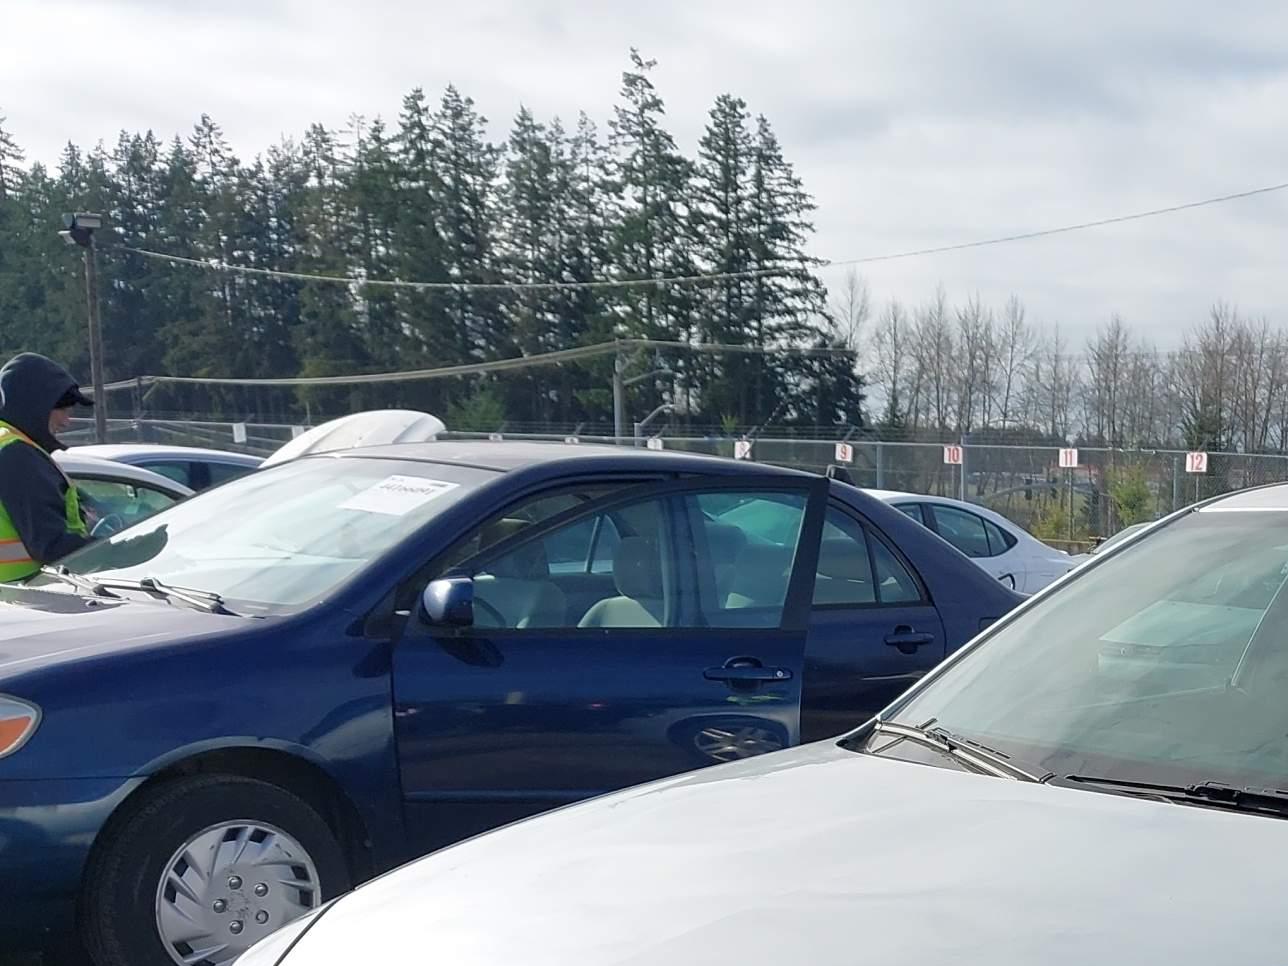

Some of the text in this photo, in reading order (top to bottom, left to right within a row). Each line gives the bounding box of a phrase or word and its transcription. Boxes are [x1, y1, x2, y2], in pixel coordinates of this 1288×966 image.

[840, 445, 847, 460] 9
[947, 447, 960, 462] 10
[1064, 450, 1073, 466] 11
[1190, 454, 1203, 471] 12
